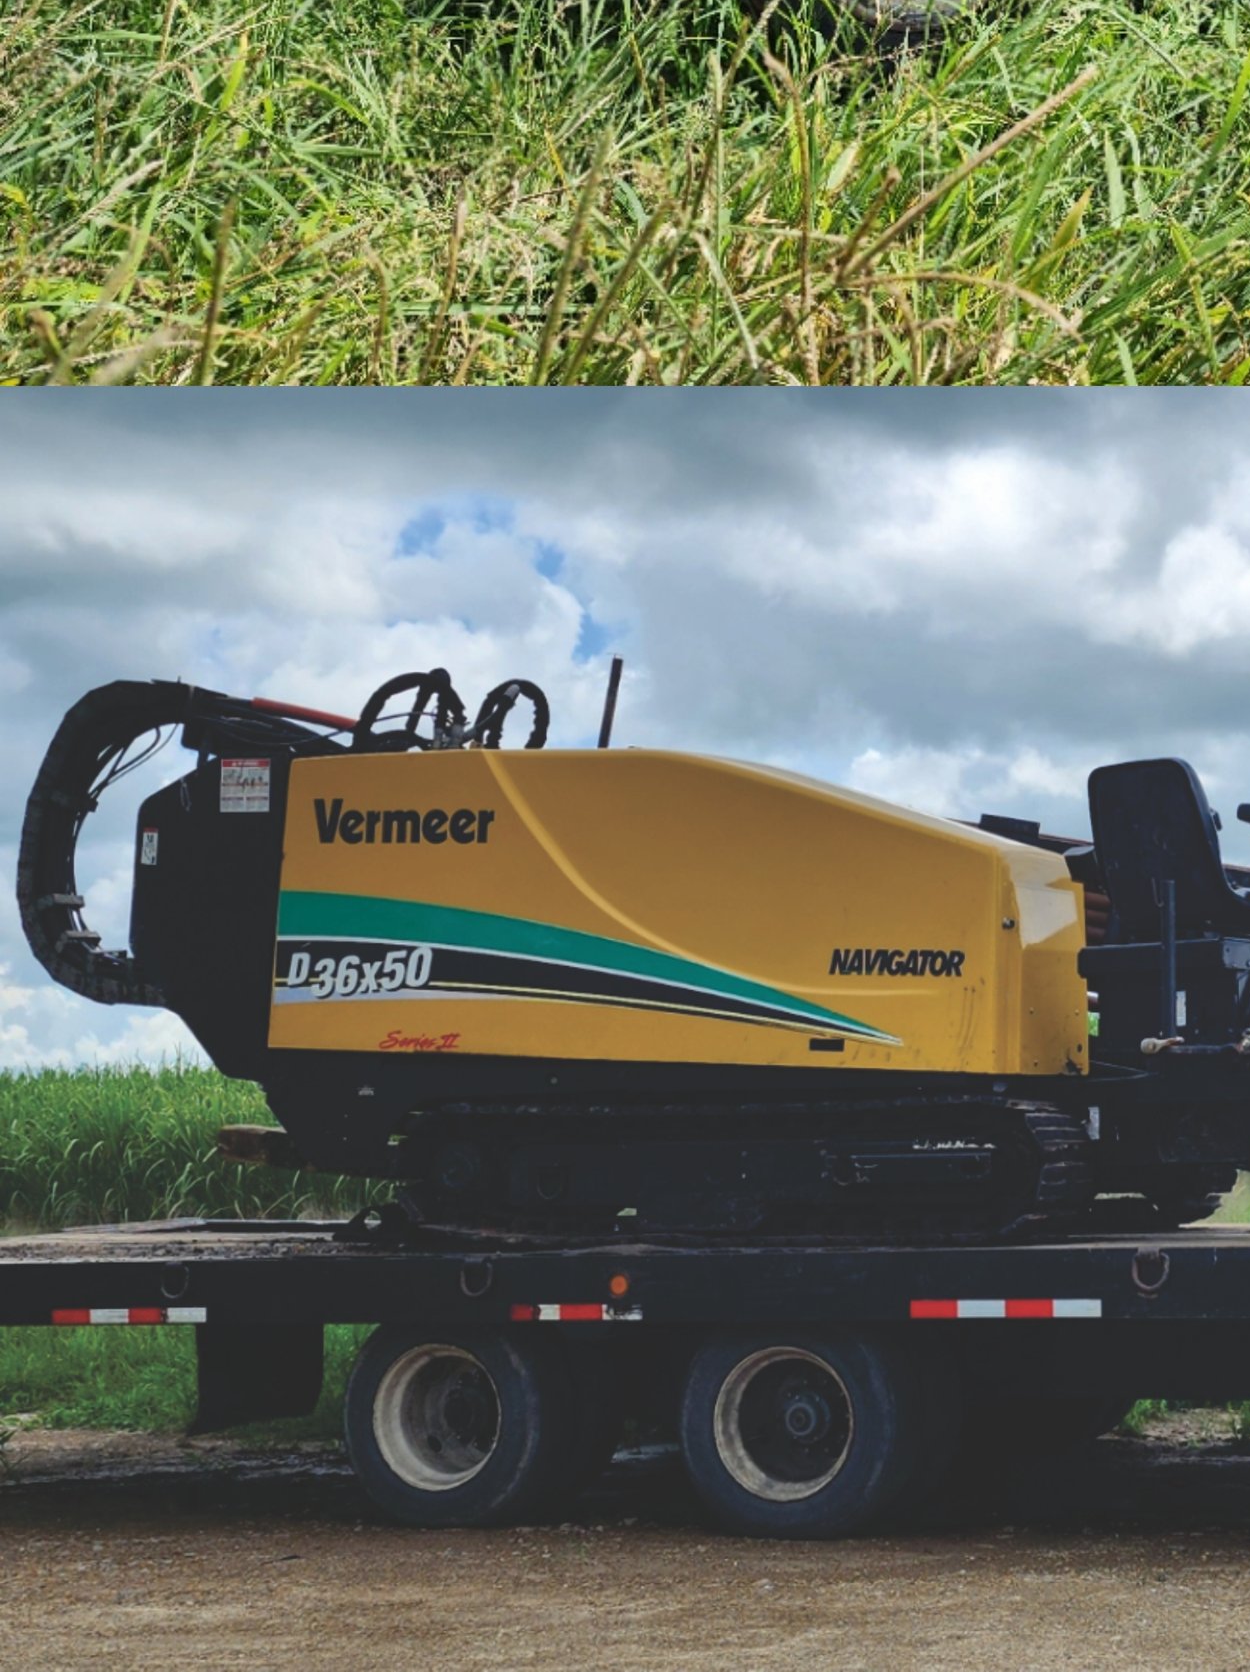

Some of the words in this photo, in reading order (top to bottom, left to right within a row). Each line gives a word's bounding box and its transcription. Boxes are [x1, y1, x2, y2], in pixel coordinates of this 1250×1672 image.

[313, 798, 494, 844] Vermeer
[829, 949, 965, 977] NAVIGATOR
[379, 1030, 437, 1050] Series
